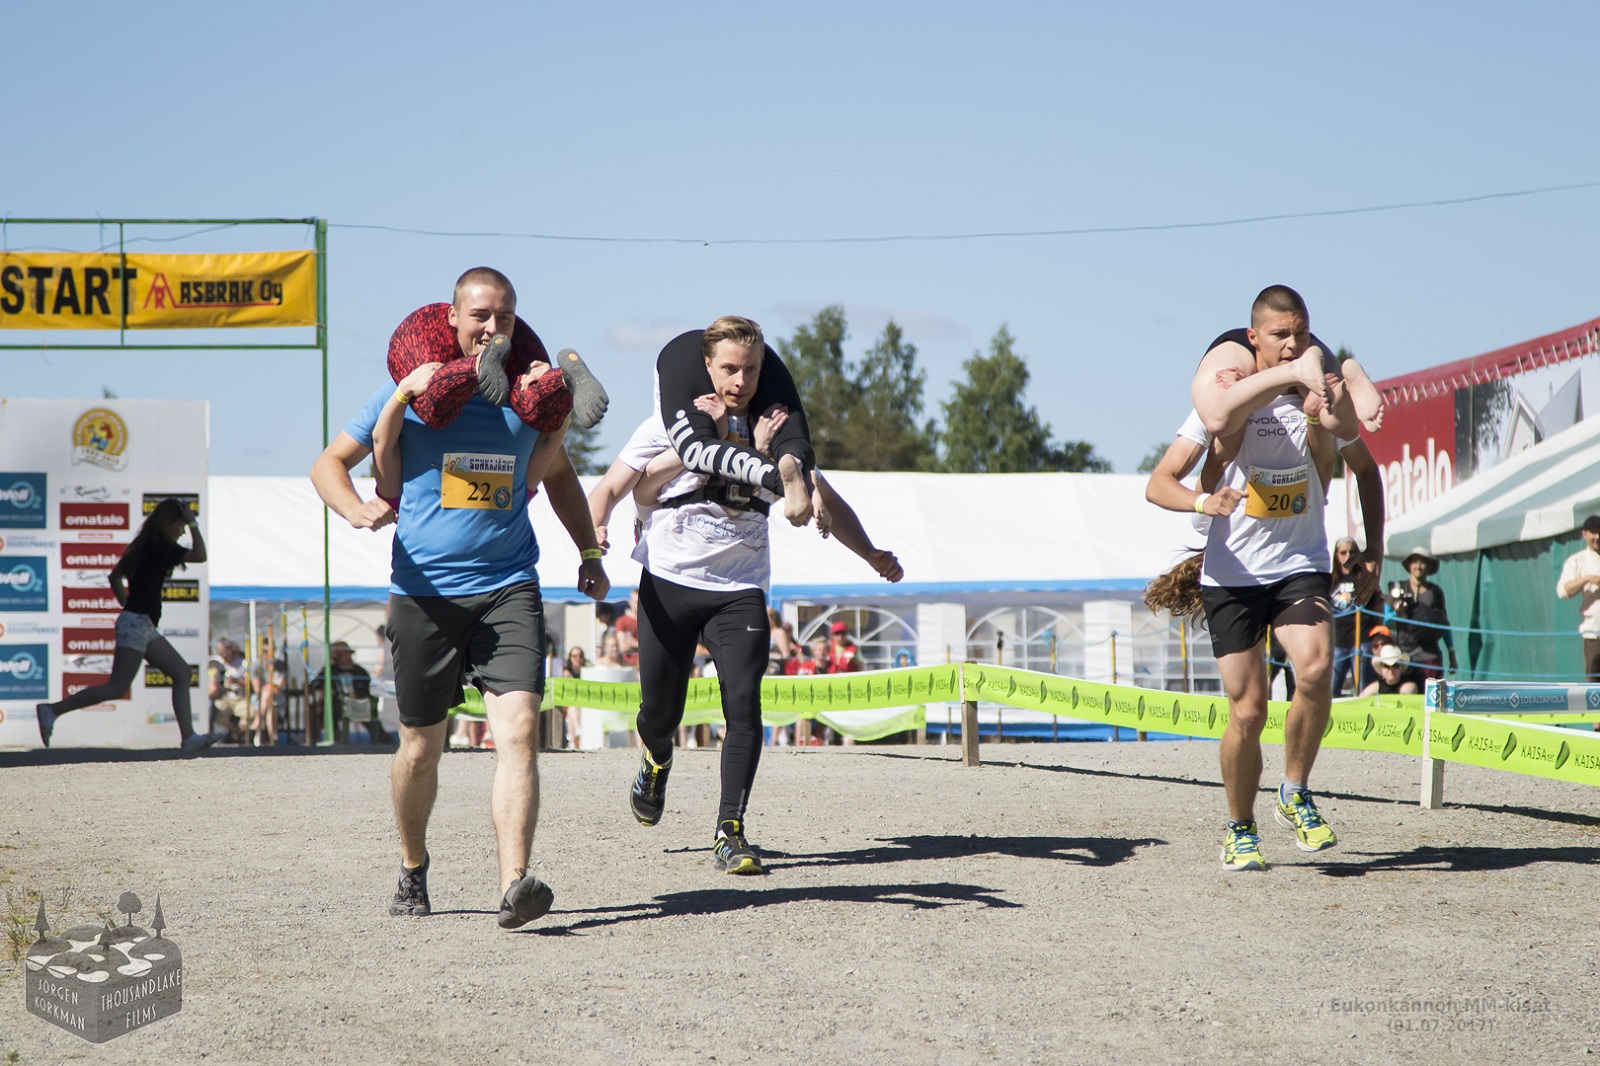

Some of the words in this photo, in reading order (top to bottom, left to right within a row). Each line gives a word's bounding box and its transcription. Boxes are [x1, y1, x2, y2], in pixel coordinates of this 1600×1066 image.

[1, 266, 137, 315] START
[180, 282, 253, 303] ASBRAK
[261, 281, 283, 305] Oy
[683, 441, 721, 474] DO
[719, 447, 774, 486] JUST
[467, 482, 491, 501] 22
[1350, 437, 1452, 526] oatalo
[1267, 494, 1290, 511] 20
[65, 514, 125, 526] omatalo
[1337, 721, 1363, 735] KAISAnet
[1377, 724, 1402, 738] KAISAnet
[1468, 736, 1502, 753] KAISAnet
[1521, 744, 1555, 762] KAISAnet
